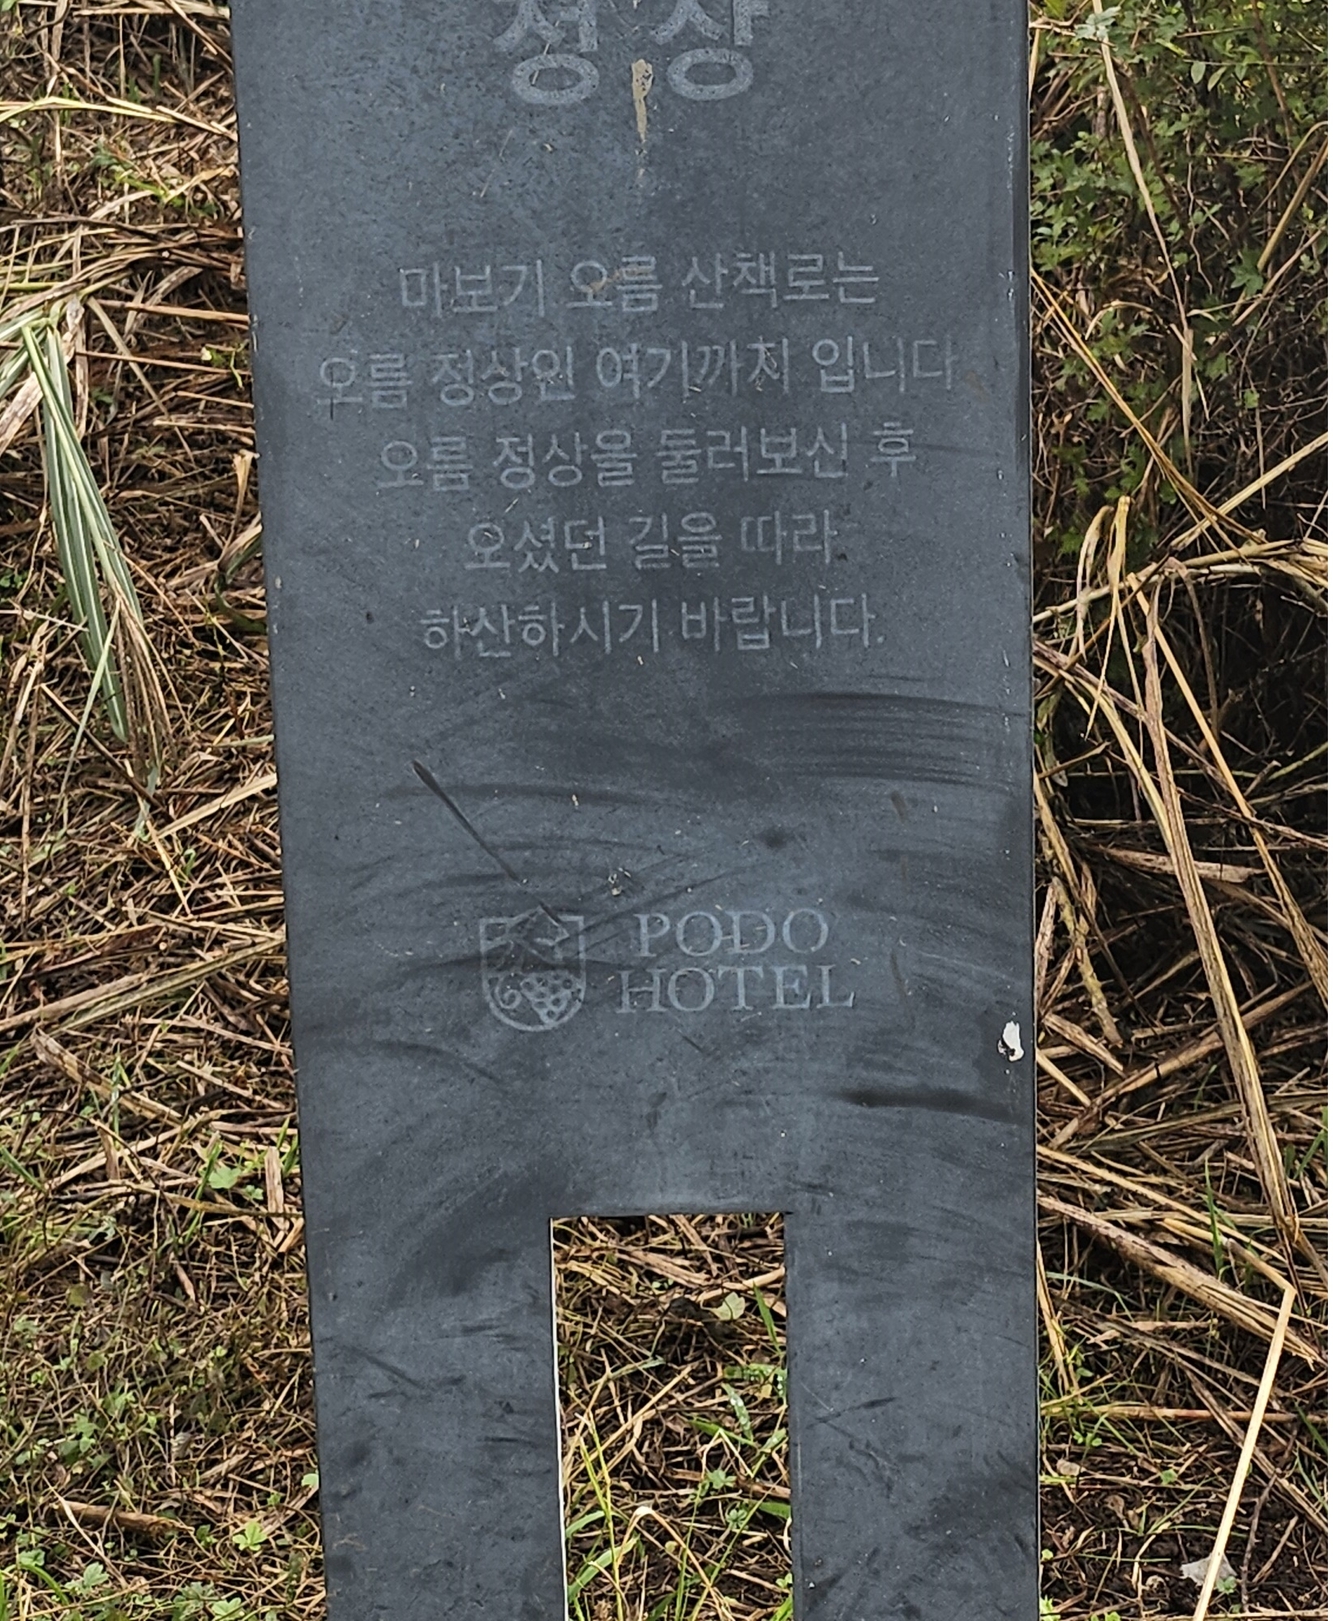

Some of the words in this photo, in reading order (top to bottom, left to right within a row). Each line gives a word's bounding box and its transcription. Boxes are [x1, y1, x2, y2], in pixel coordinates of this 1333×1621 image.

[400, 259, 545, 317] 마보기
[566, 254, 661, 313] 오름
[681, 251, 879, 309] 산책로는
[317, 352, 413, 409] 오름
[430, 347, 575, 407] 정상인
[596, 337, 789, 399] 여기까지
[812, 335, 957, 393] 입니다
[378, 435, 473, 492] 오름
[494, 429, 637, 489] 정상을
[654, 422, 849, 485] 둘러보신
[869, 420, 918, 478] 후
[466, 517, 608, 573] 오셨던
[629, 511, 723, 570] 길을
[741, 509, 838, 565] 따라
[420, 598, 660, 658] 하산하시기
[681, 593, 885, 653] 바랍니다.
[633, 908, 831, 958] PODO
[617, 964, 856, 1014] HOTEL
